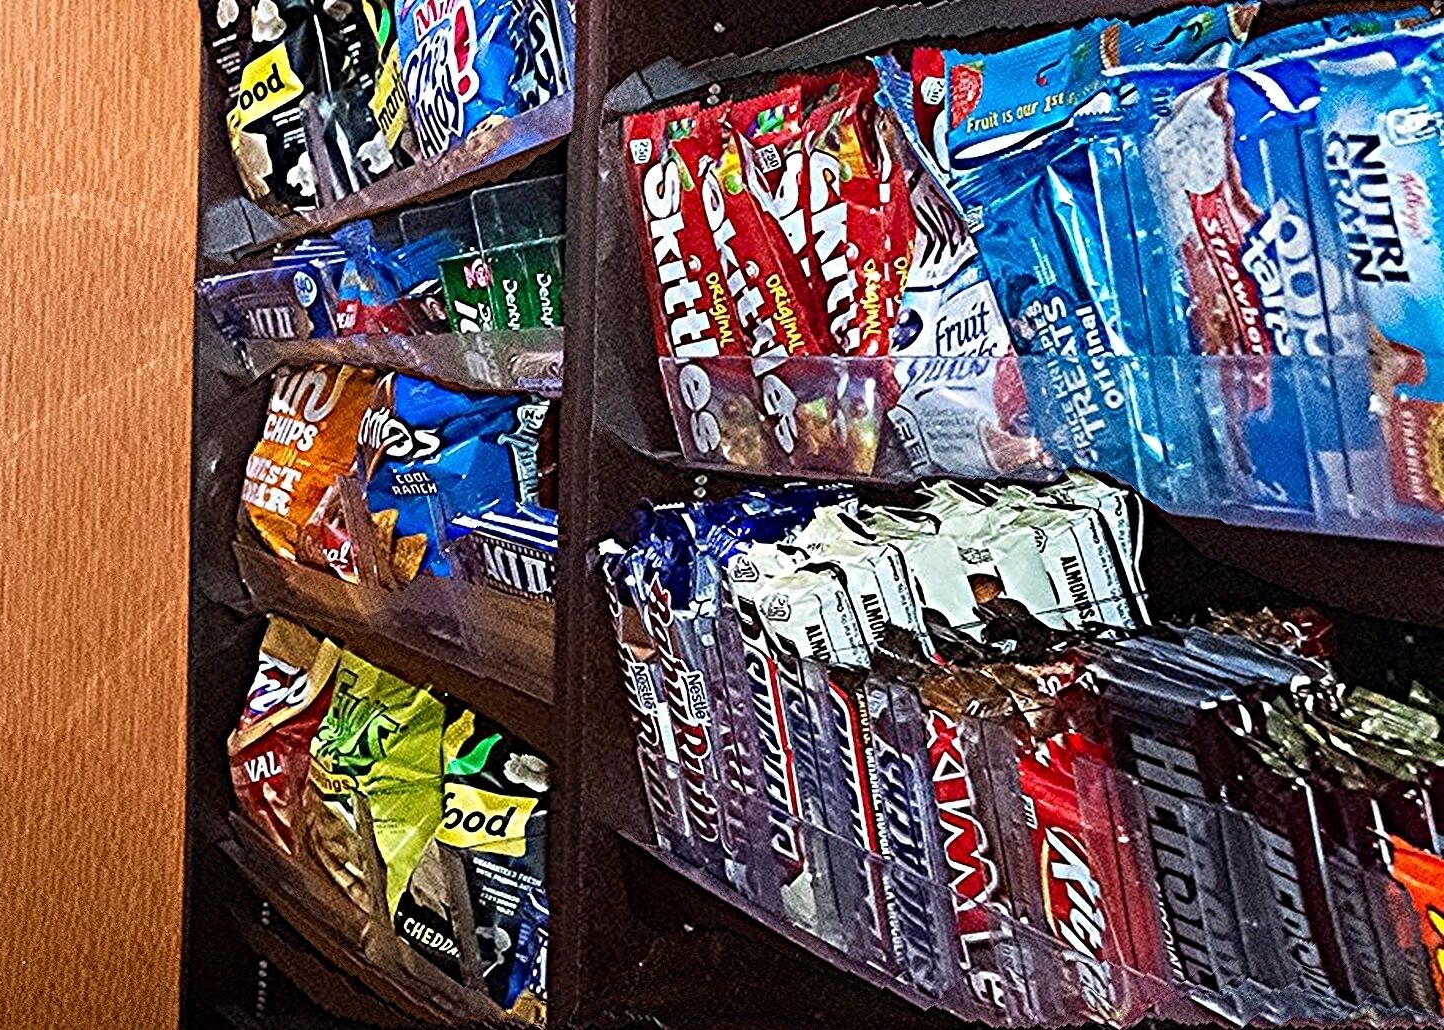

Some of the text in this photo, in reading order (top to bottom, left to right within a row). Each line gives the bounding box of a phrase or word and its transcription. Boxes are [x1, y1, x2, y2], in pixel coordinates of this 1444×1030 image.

[966, 94, 1065, 134] Fruit is our 1st
[637, 140, 650, 162] 250
[762, 146, 780, 169] 250
[1347, 134, 1410, 282] NUTRI
[643, 160, 721, 453] Skittles
[1044, 297, 1105, 441] TREATS
[1075, 305, 1124, 410] Original
[263, 413, 319, 452] CHIPS
[1061, 400, 1090, 449] RICE
[391, 482, 438, 496] RANCH
[395, 471, 431, 485] COOL
[1060, 555, 1095, 620] ALMONDS
